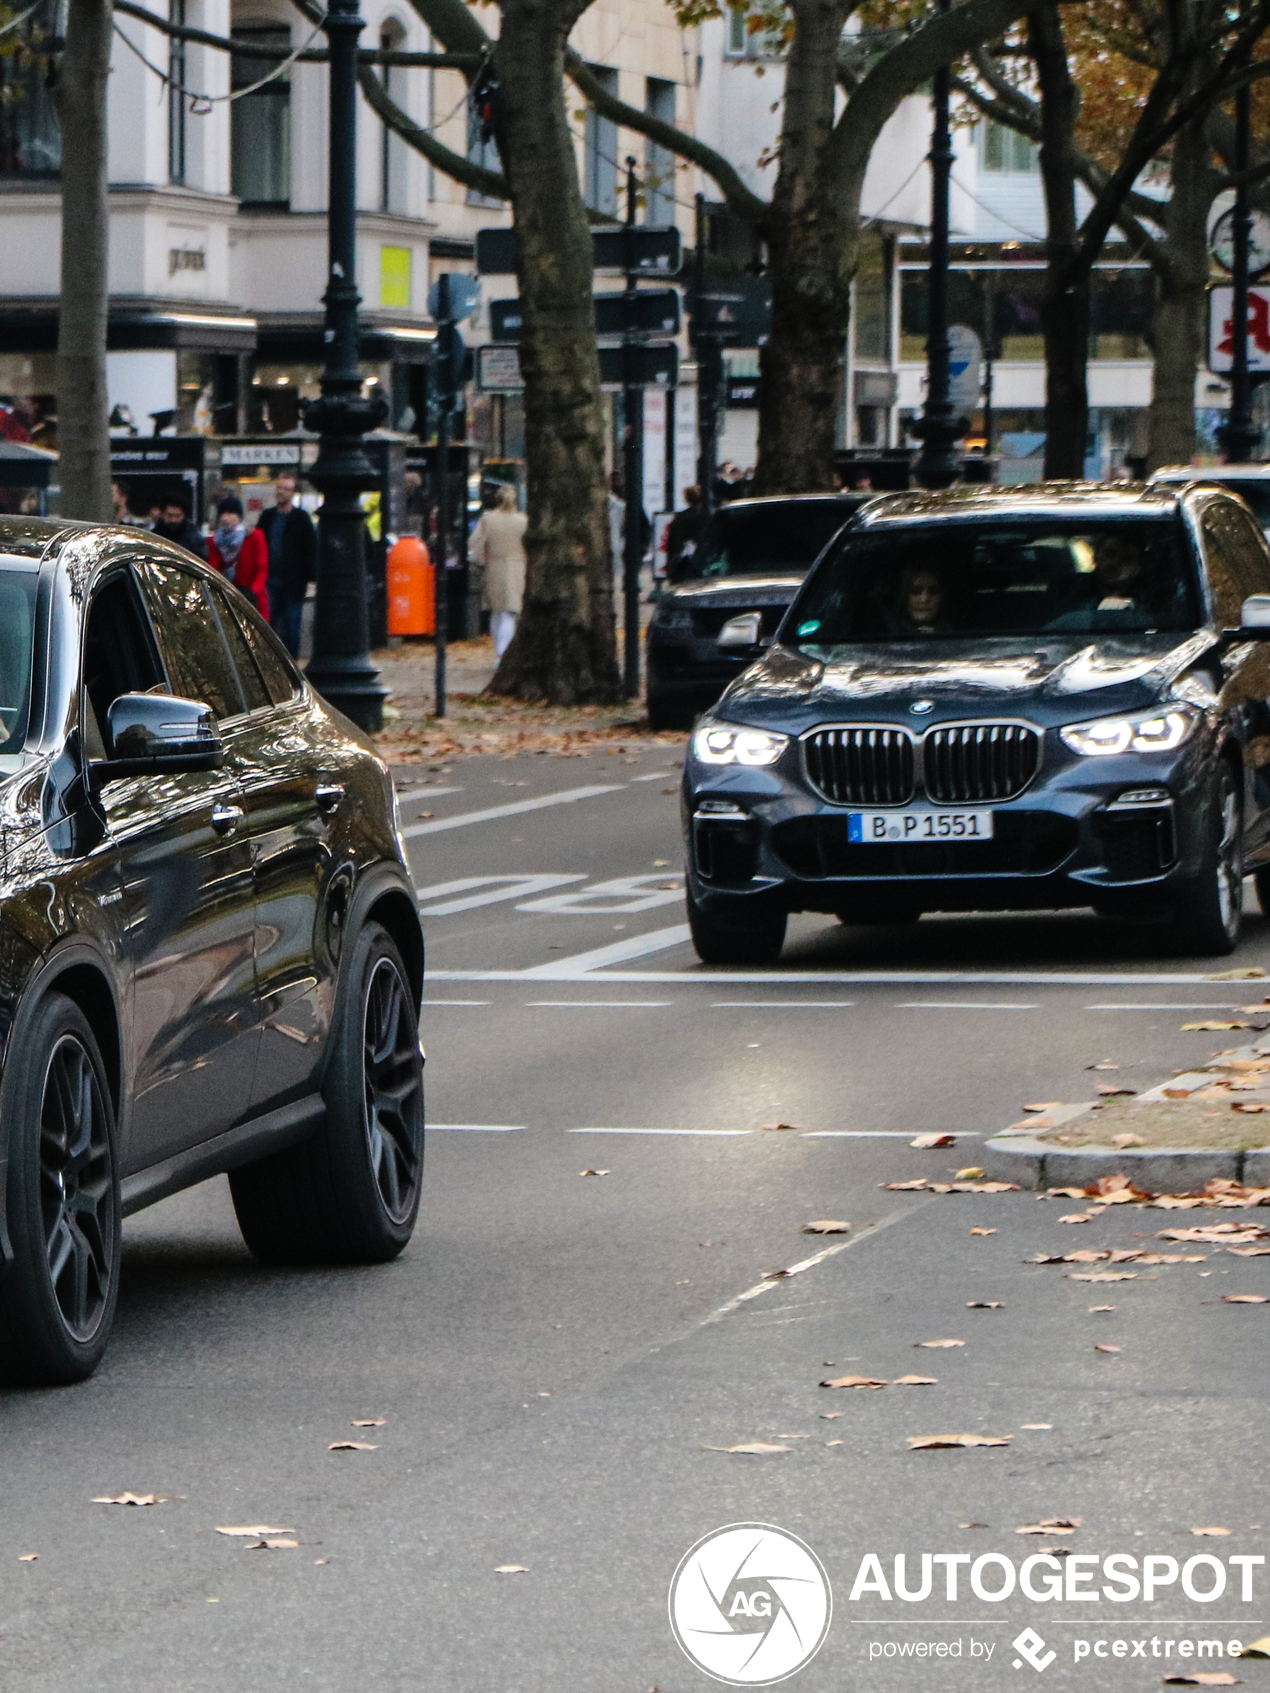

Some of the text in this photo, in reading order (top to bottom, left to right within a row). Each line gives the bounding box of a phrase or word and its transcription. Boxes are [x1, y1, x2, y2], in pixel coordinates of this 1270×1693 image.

[873, 815, 981, 838] B P 1551
